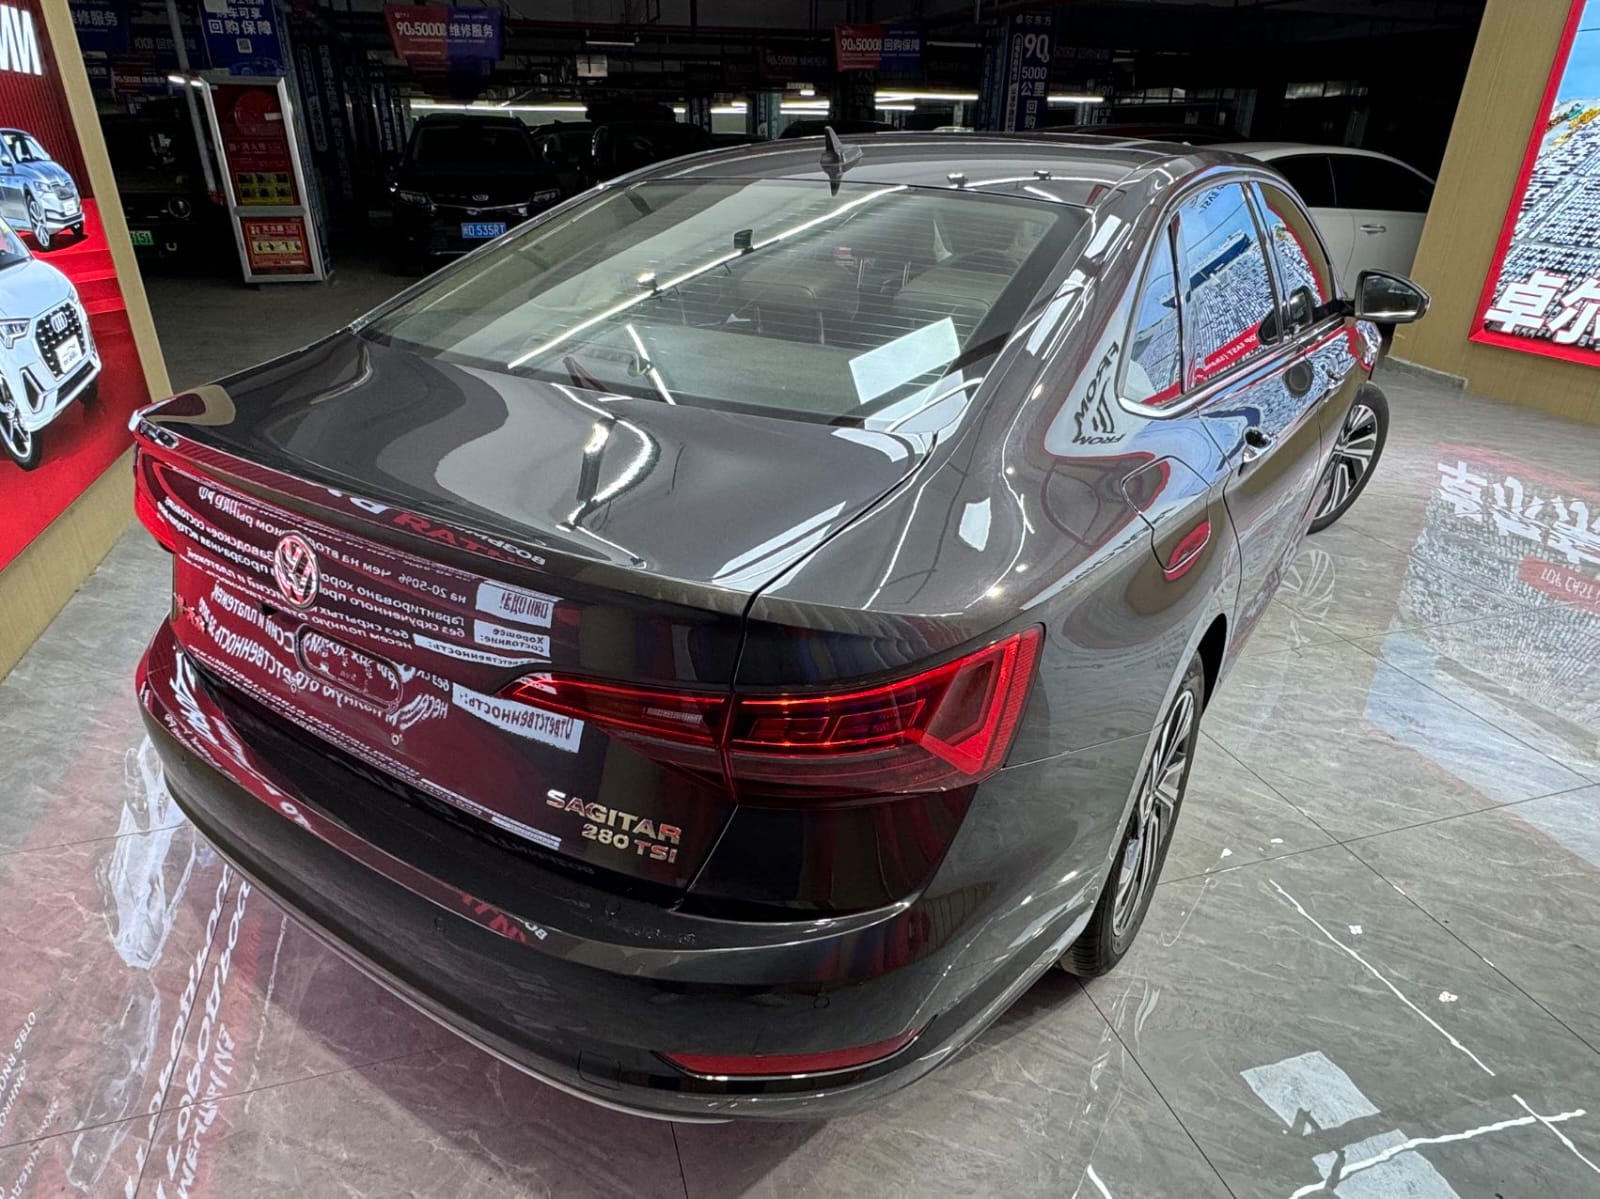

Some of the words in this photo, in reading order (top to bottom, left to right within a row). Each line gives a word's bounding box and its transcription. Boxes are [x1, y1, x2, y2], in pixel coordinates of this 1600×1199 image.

[1021, 66, 1048, 81] 5000
[546, 789, 682, 845] SAGITAR
[581, 823, 630, 850] 280
[634, 839, 678, 864] TSI
